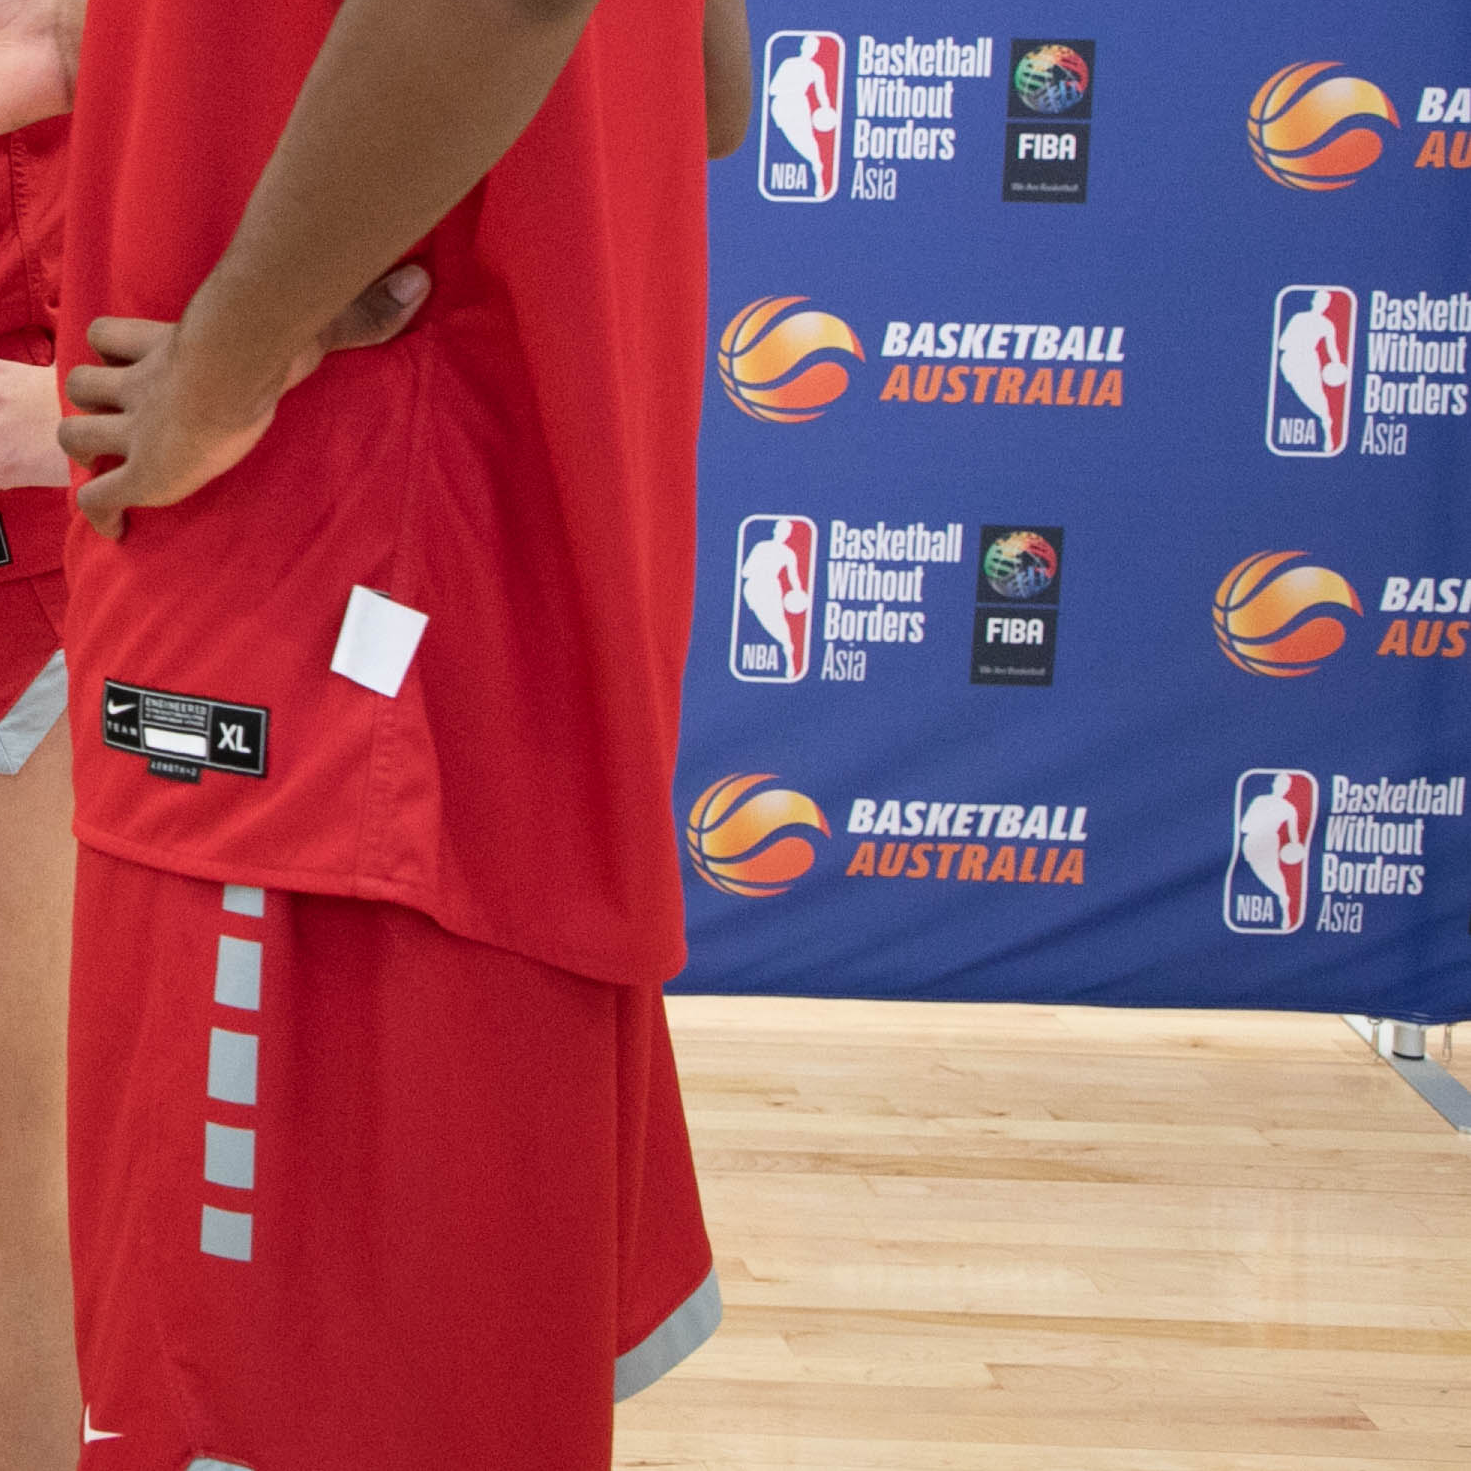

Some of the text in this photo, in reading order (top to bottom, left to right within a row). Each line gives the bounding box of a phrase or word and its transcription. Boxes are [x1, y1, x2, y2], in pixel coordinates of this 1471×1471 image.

[859, 36, 992, 77] Basketball
[857, 77, 953, 118] Without
[854, 119, 955, 160] Borders
[1019, 134, 1076, 159] FIBA
[771, 163, 807, 189] NBA
[851, 160, 896, 200] Asia
[882, 322, 1124, 361] BASKETBALL
[1369, 332, 1467, 373] Without
[880, 365, 1122, 406] AUSTRALIA
[1364, 374, 1468, 415] Borders
[1279, 418, 1316, 444] NBA
[1361, 415, 1407, 455] Asia
[830, 520, 962, 562] Basketball
[828, 561, 923, 602] Without
[824, 602, 925, 642] Borders
[987, 618, 1043, 644] FIBA
[743, 644, 778, 670] NBA
[821, 642, 866, 681] Asia
[107, 720, 138, 737] TEAM
[217, 722, 252, 754] XL
[1331, 775, 1465, 815] Basketball
[848, 799, 1087, 841] BASKETBALL
[1326, 815, 1424, 855] Without
[846, 842, 1083, 884] AUSTRALIA
[1322, 853, 1424, 894] Borders
[1237, 895, 1273, 922] NBA
[1317, 894, 1363, 933] Asia
